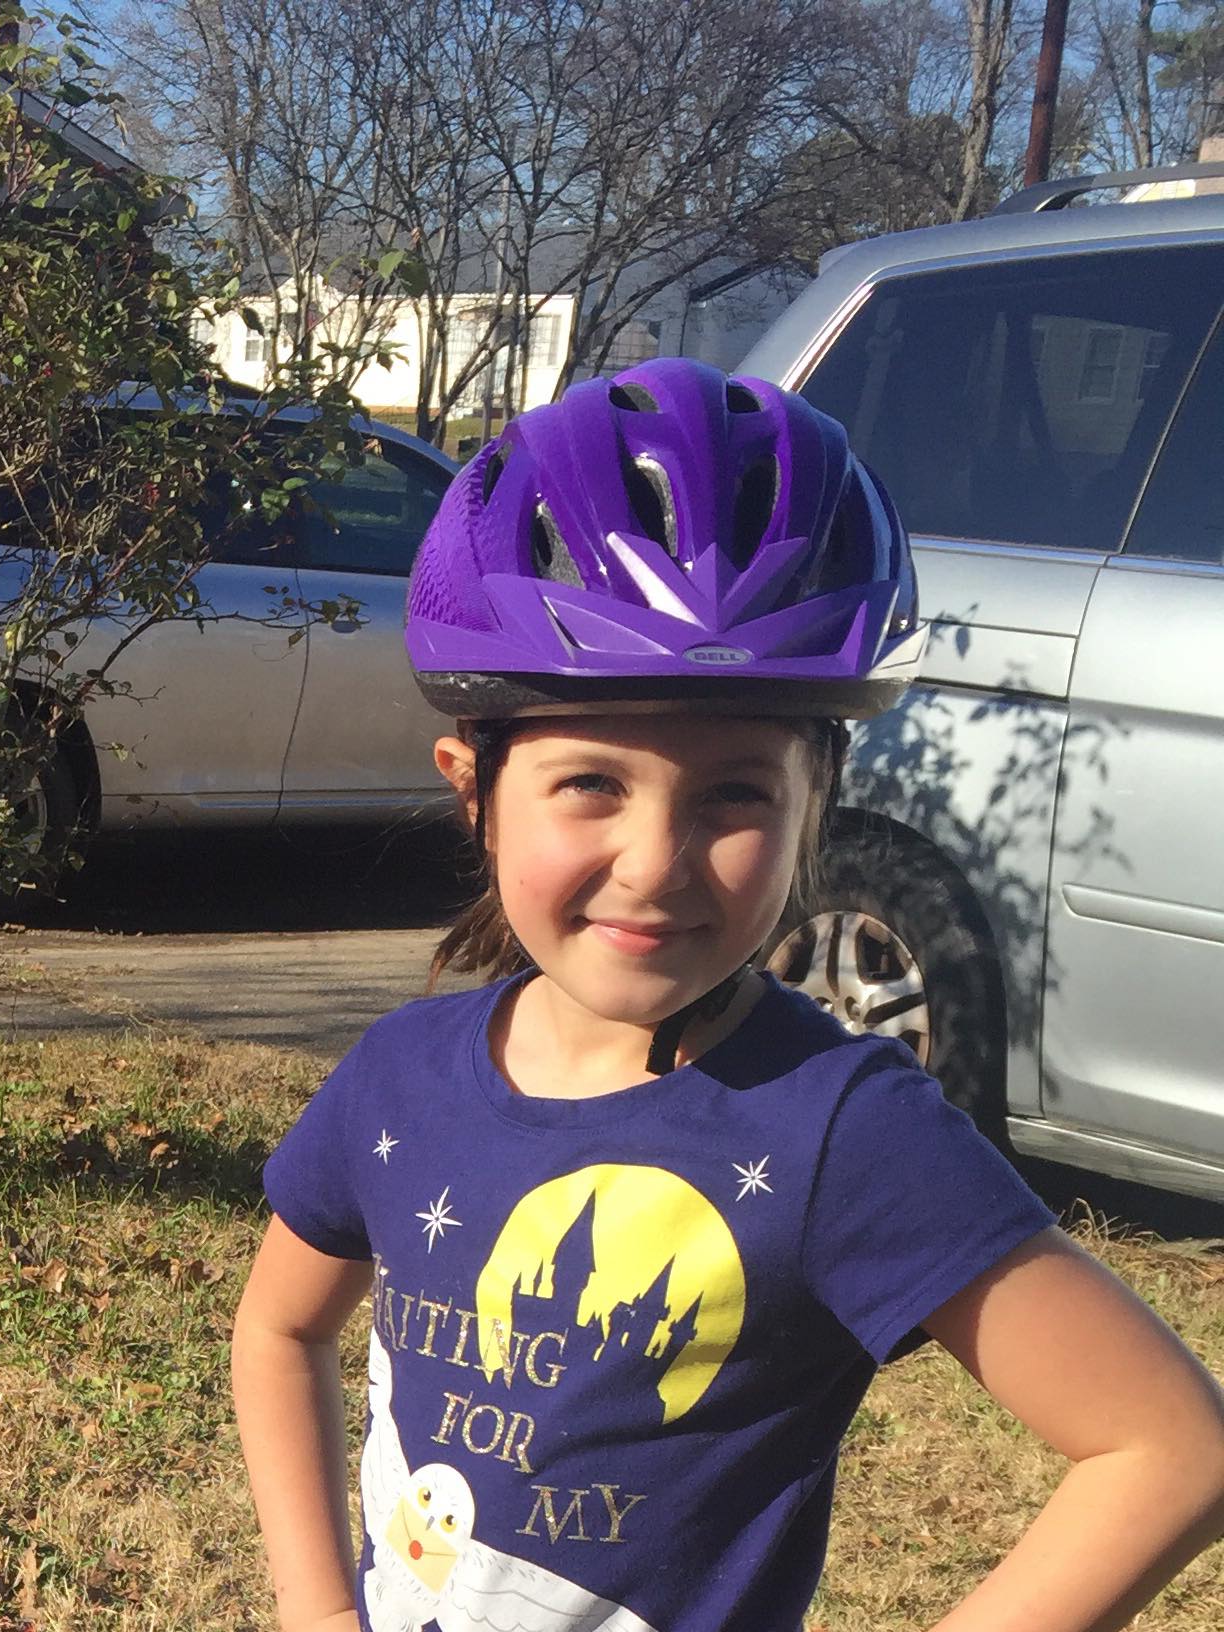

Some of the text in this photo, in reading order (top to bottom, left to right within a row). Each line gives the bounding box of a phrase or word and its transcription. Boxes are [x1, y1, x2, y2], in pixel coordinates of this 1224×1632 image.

[694, 651, 741, 662] BELL
[430, 1391, 535, 1474] FOR
[515, 1483, 649, 1545] MY
